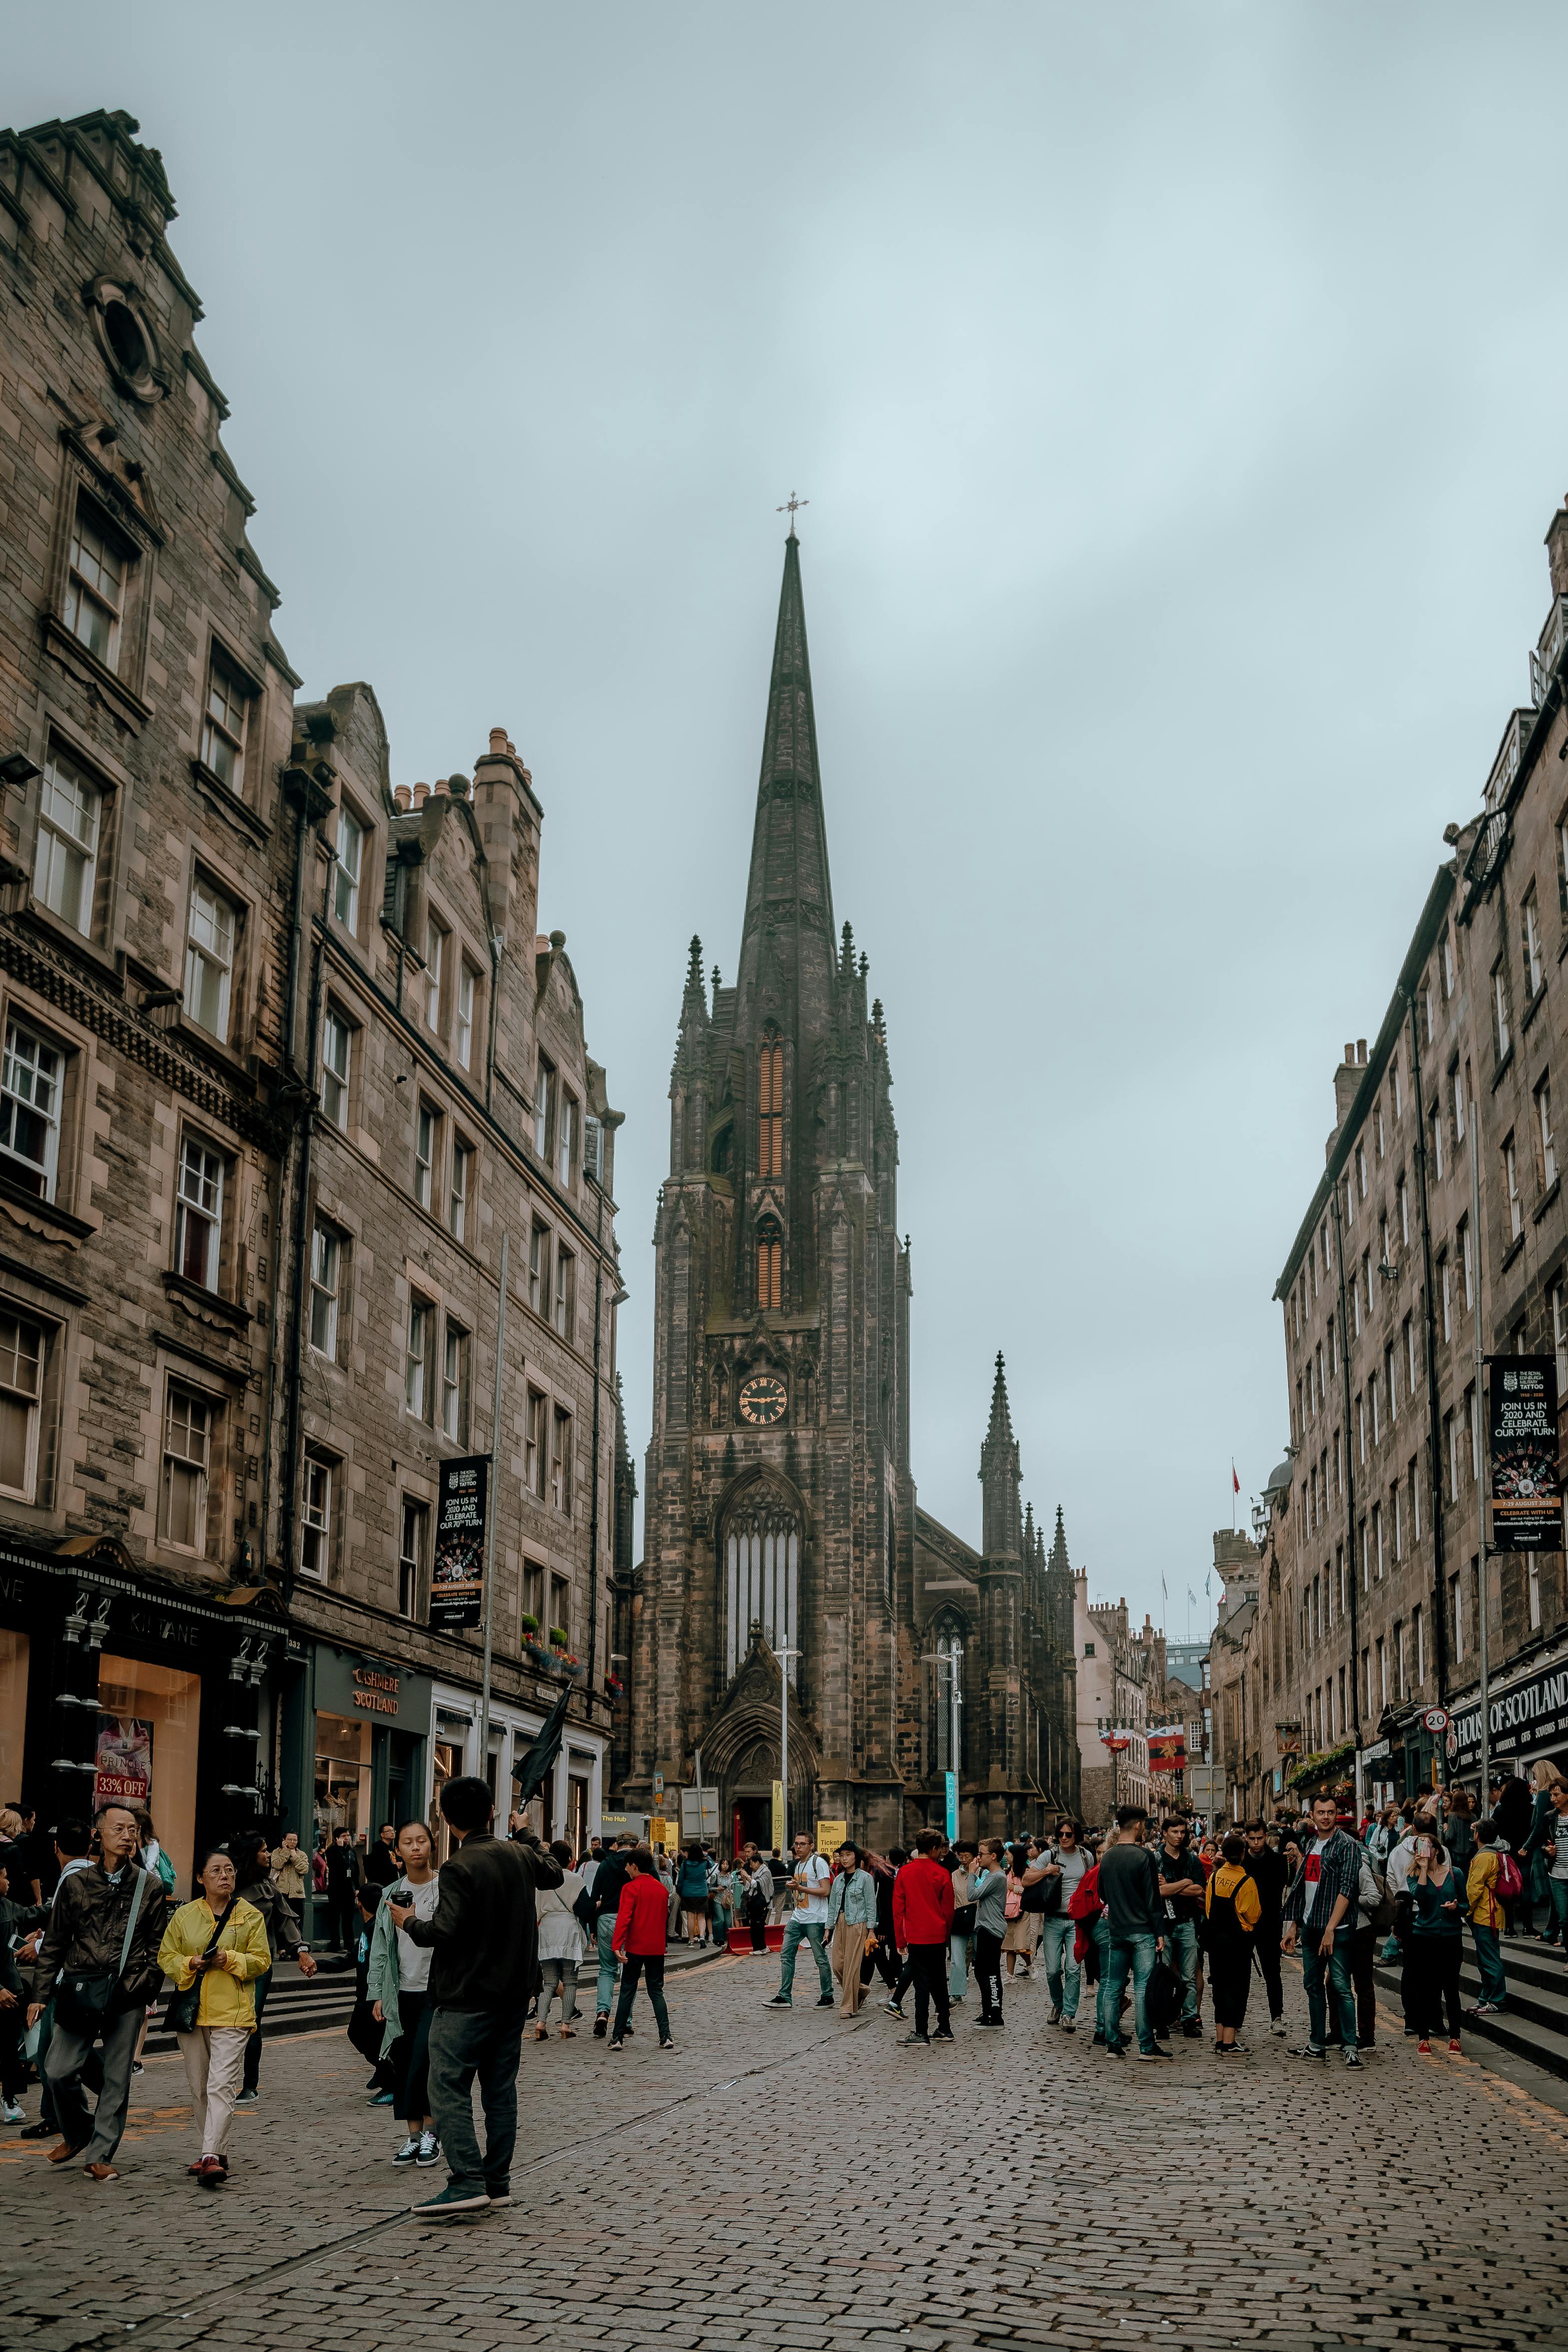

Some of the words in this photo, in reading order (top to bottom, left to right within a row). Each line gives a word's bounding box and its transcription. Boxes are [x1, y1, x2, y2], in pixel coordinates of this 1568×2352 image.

[1501, 1402, 1521, 1412] JOIN
[446, 1498, 459, 1507] JOIN
[445, 1512, 477, 1521] CELEBRATE
[289, 1639, 300, 1649] 332
[355, 1668, 400, 1694] CASHMERE
[355, 1691, 398, 1715] SCOTLAND
[1458, 1711, 1483, 1748] HOUS
[1490, 1701, 1506, 1734] OF
[1506, 1671, 1568, 1728] SCOTLAND
[1428, 1715, 1445, 1726] 20
[1521, 1731, 1531, 1743] GIFTS
[100, 1756, 146, 1770] PRINGLE
[100, 1777, 121, 1793] 33%
[124, 1780, 145, 1795] OFF
[1216, 1876, 1237, 1888] TAFF
[990, 1975, 999, 2000] Hurley
